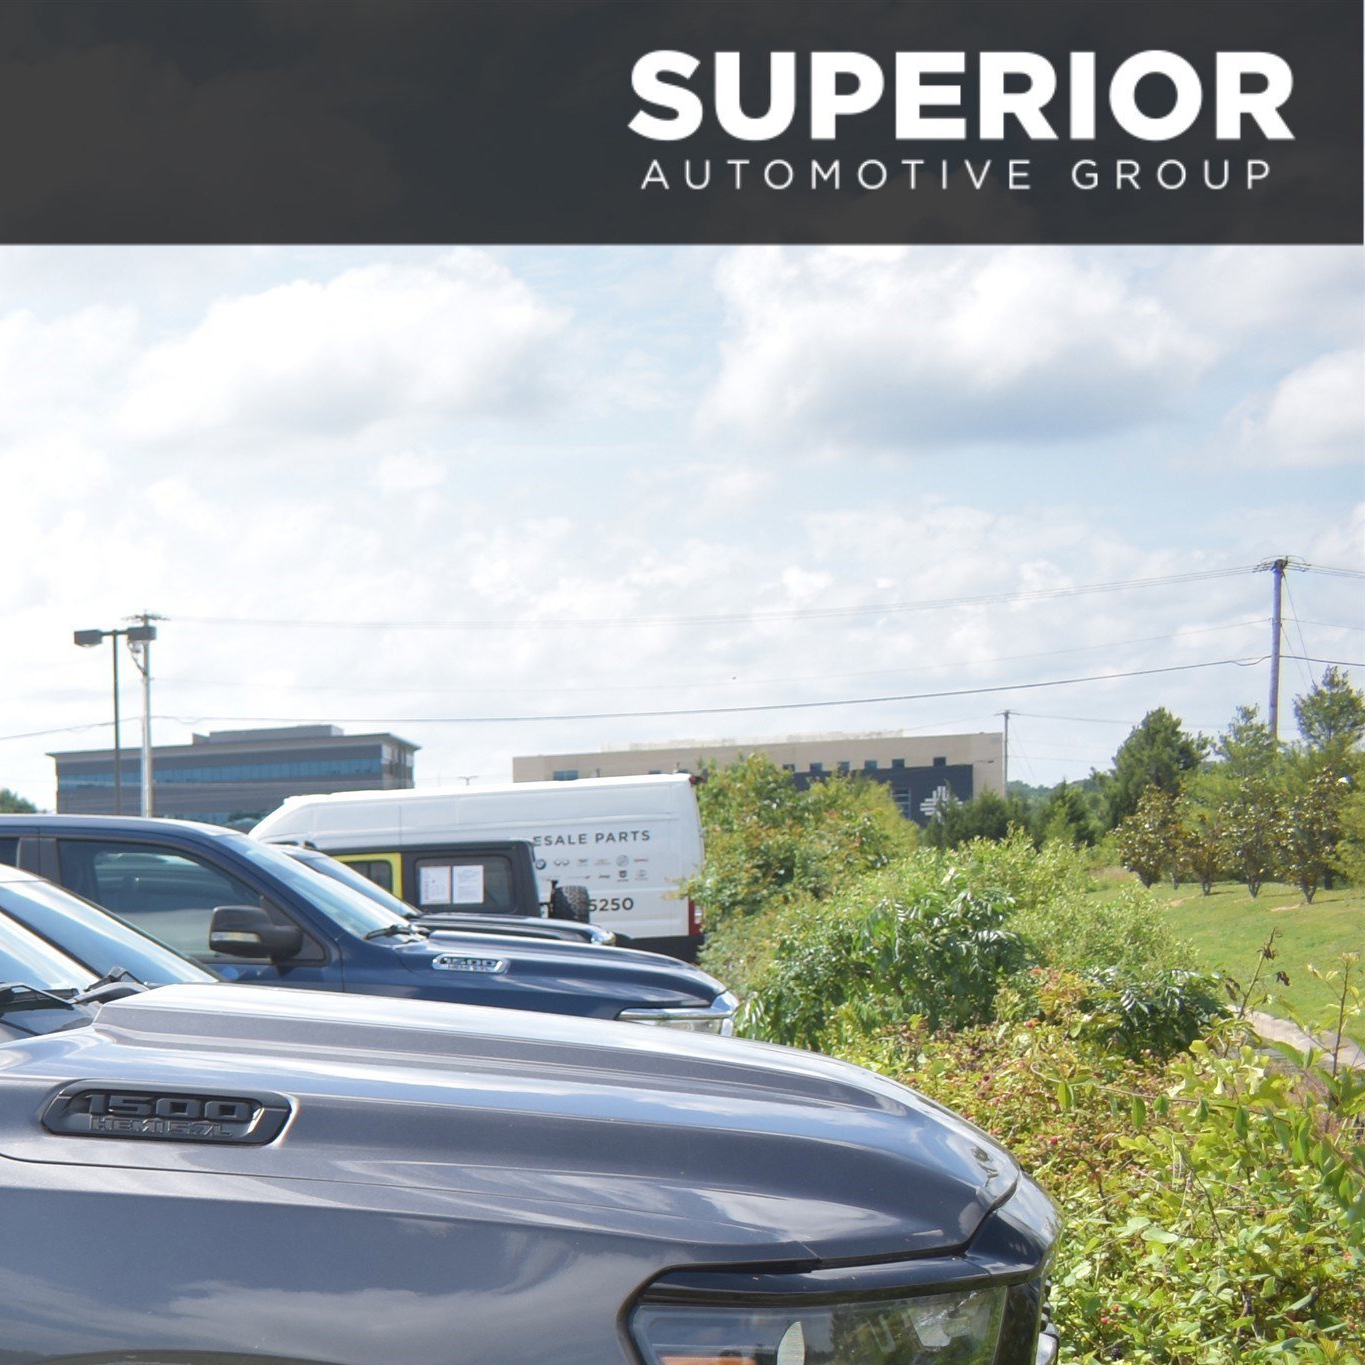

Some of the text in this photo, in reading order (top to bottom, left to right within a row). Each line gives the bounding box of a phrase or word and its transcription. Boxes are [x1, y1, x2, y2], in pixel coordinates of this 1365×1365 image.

[595, 830, 650, 843] PARTS
[84, 1092, 253, 1121] 1500
[90, 1114, 165, 1136] HEMI
